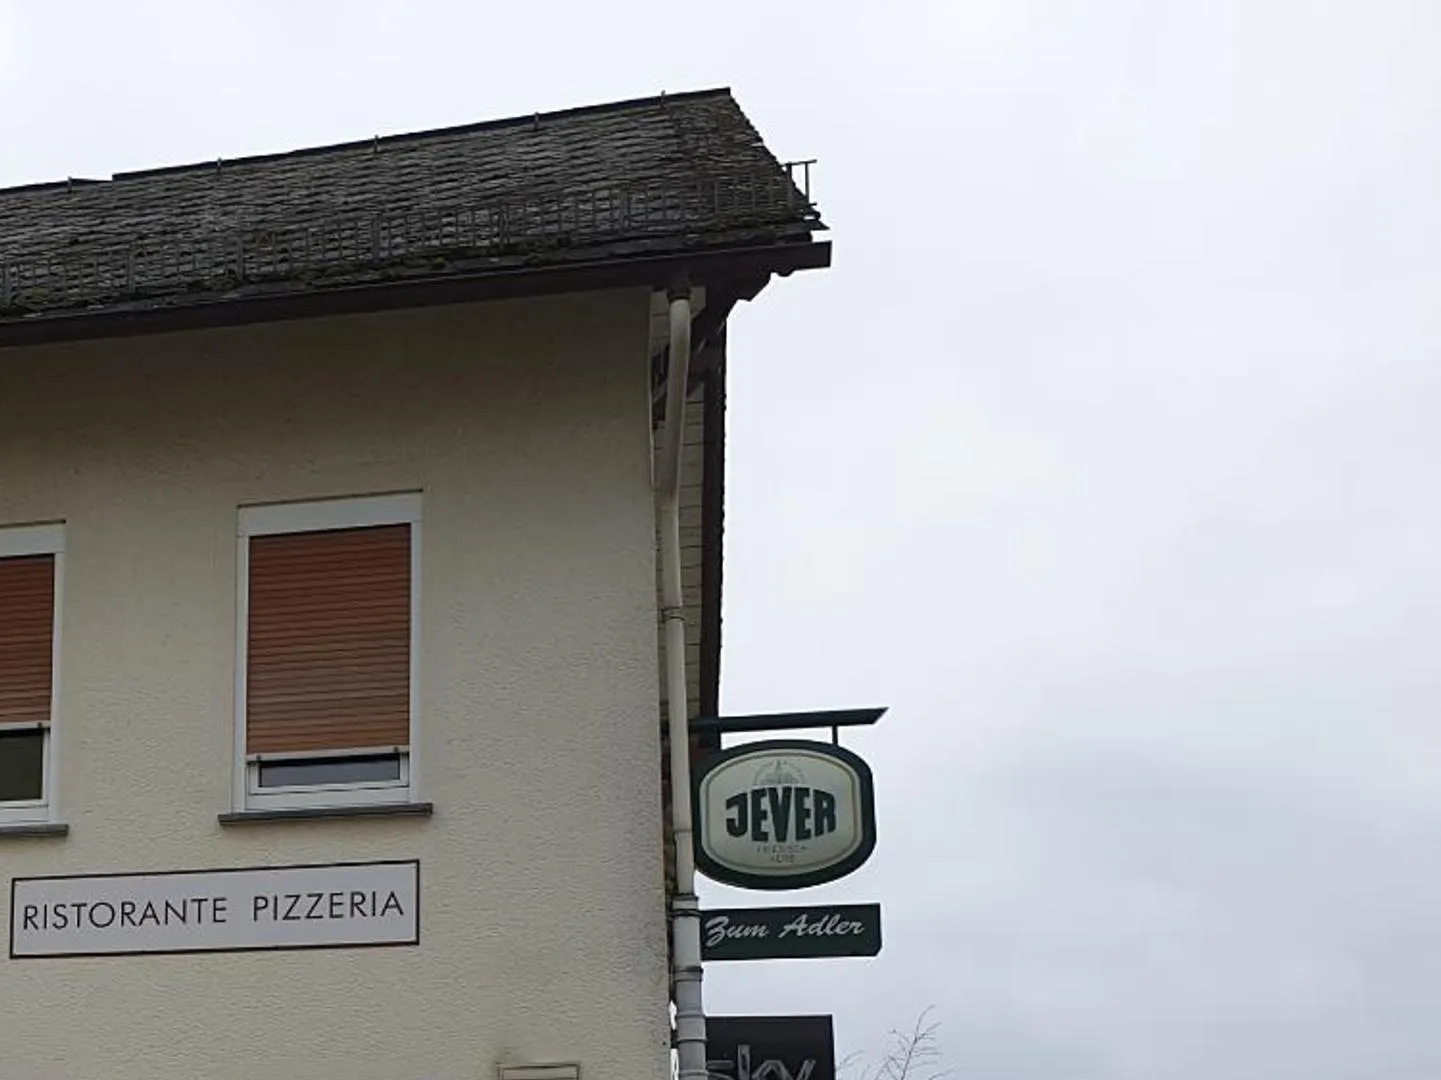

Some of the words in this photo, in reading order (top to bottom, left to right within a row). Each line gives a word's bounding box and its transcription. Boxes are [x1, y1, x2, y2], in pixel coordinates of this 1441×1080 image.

[726, 787, 836, 842] JEVER
[23, 897, 227, 931] RISTORANTE
[253, 891, 404, 922] PIZZERIA
[705, 915, 768, 946] Zum
[778, 913, 865, 938] Adler
